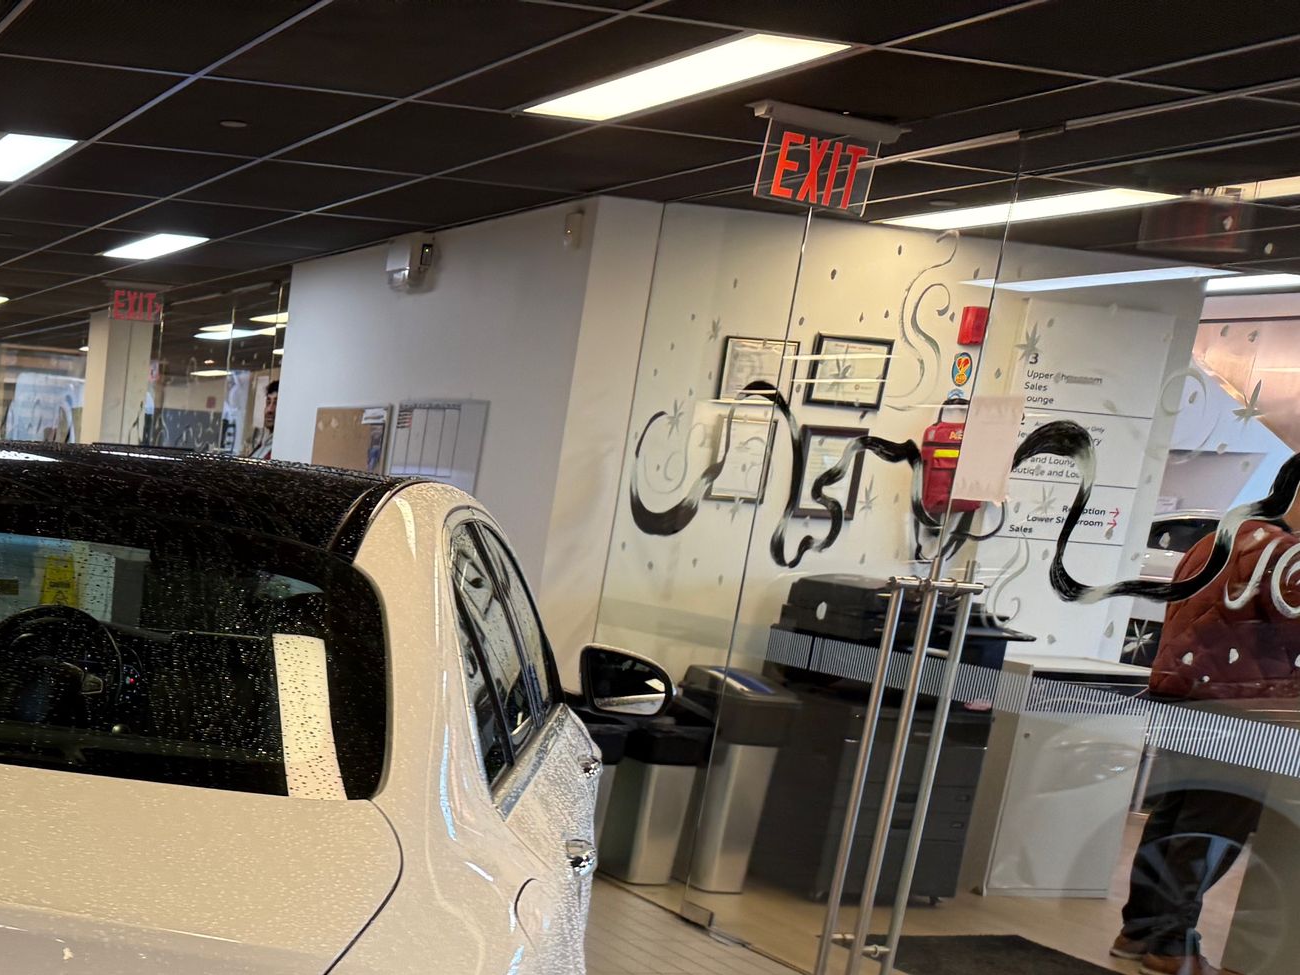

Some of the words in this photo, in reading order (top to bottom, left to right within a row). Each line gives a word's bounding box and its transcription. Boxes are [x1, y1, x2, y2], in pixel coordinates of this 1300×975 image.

[770, 131, 869, 210] EXIT
[113, 289, 157, 320] EXIT
[1029, 353, 1039, 364] 3
[1027, 370, 1054, 380] Upper
[1024, 382, 1048, 391] Sales
[1026, 396, 1054, 405] ounge
[1030, 455, 1046, 464] and
[1048, 456, 1075, 468] Loung
[1047, 470, 1064, 478] and
[1062, 505, 1106, 516] Rption
[1027, 514, 1053, 524] Lower
[1009, 524, 1033, 534] Sales
